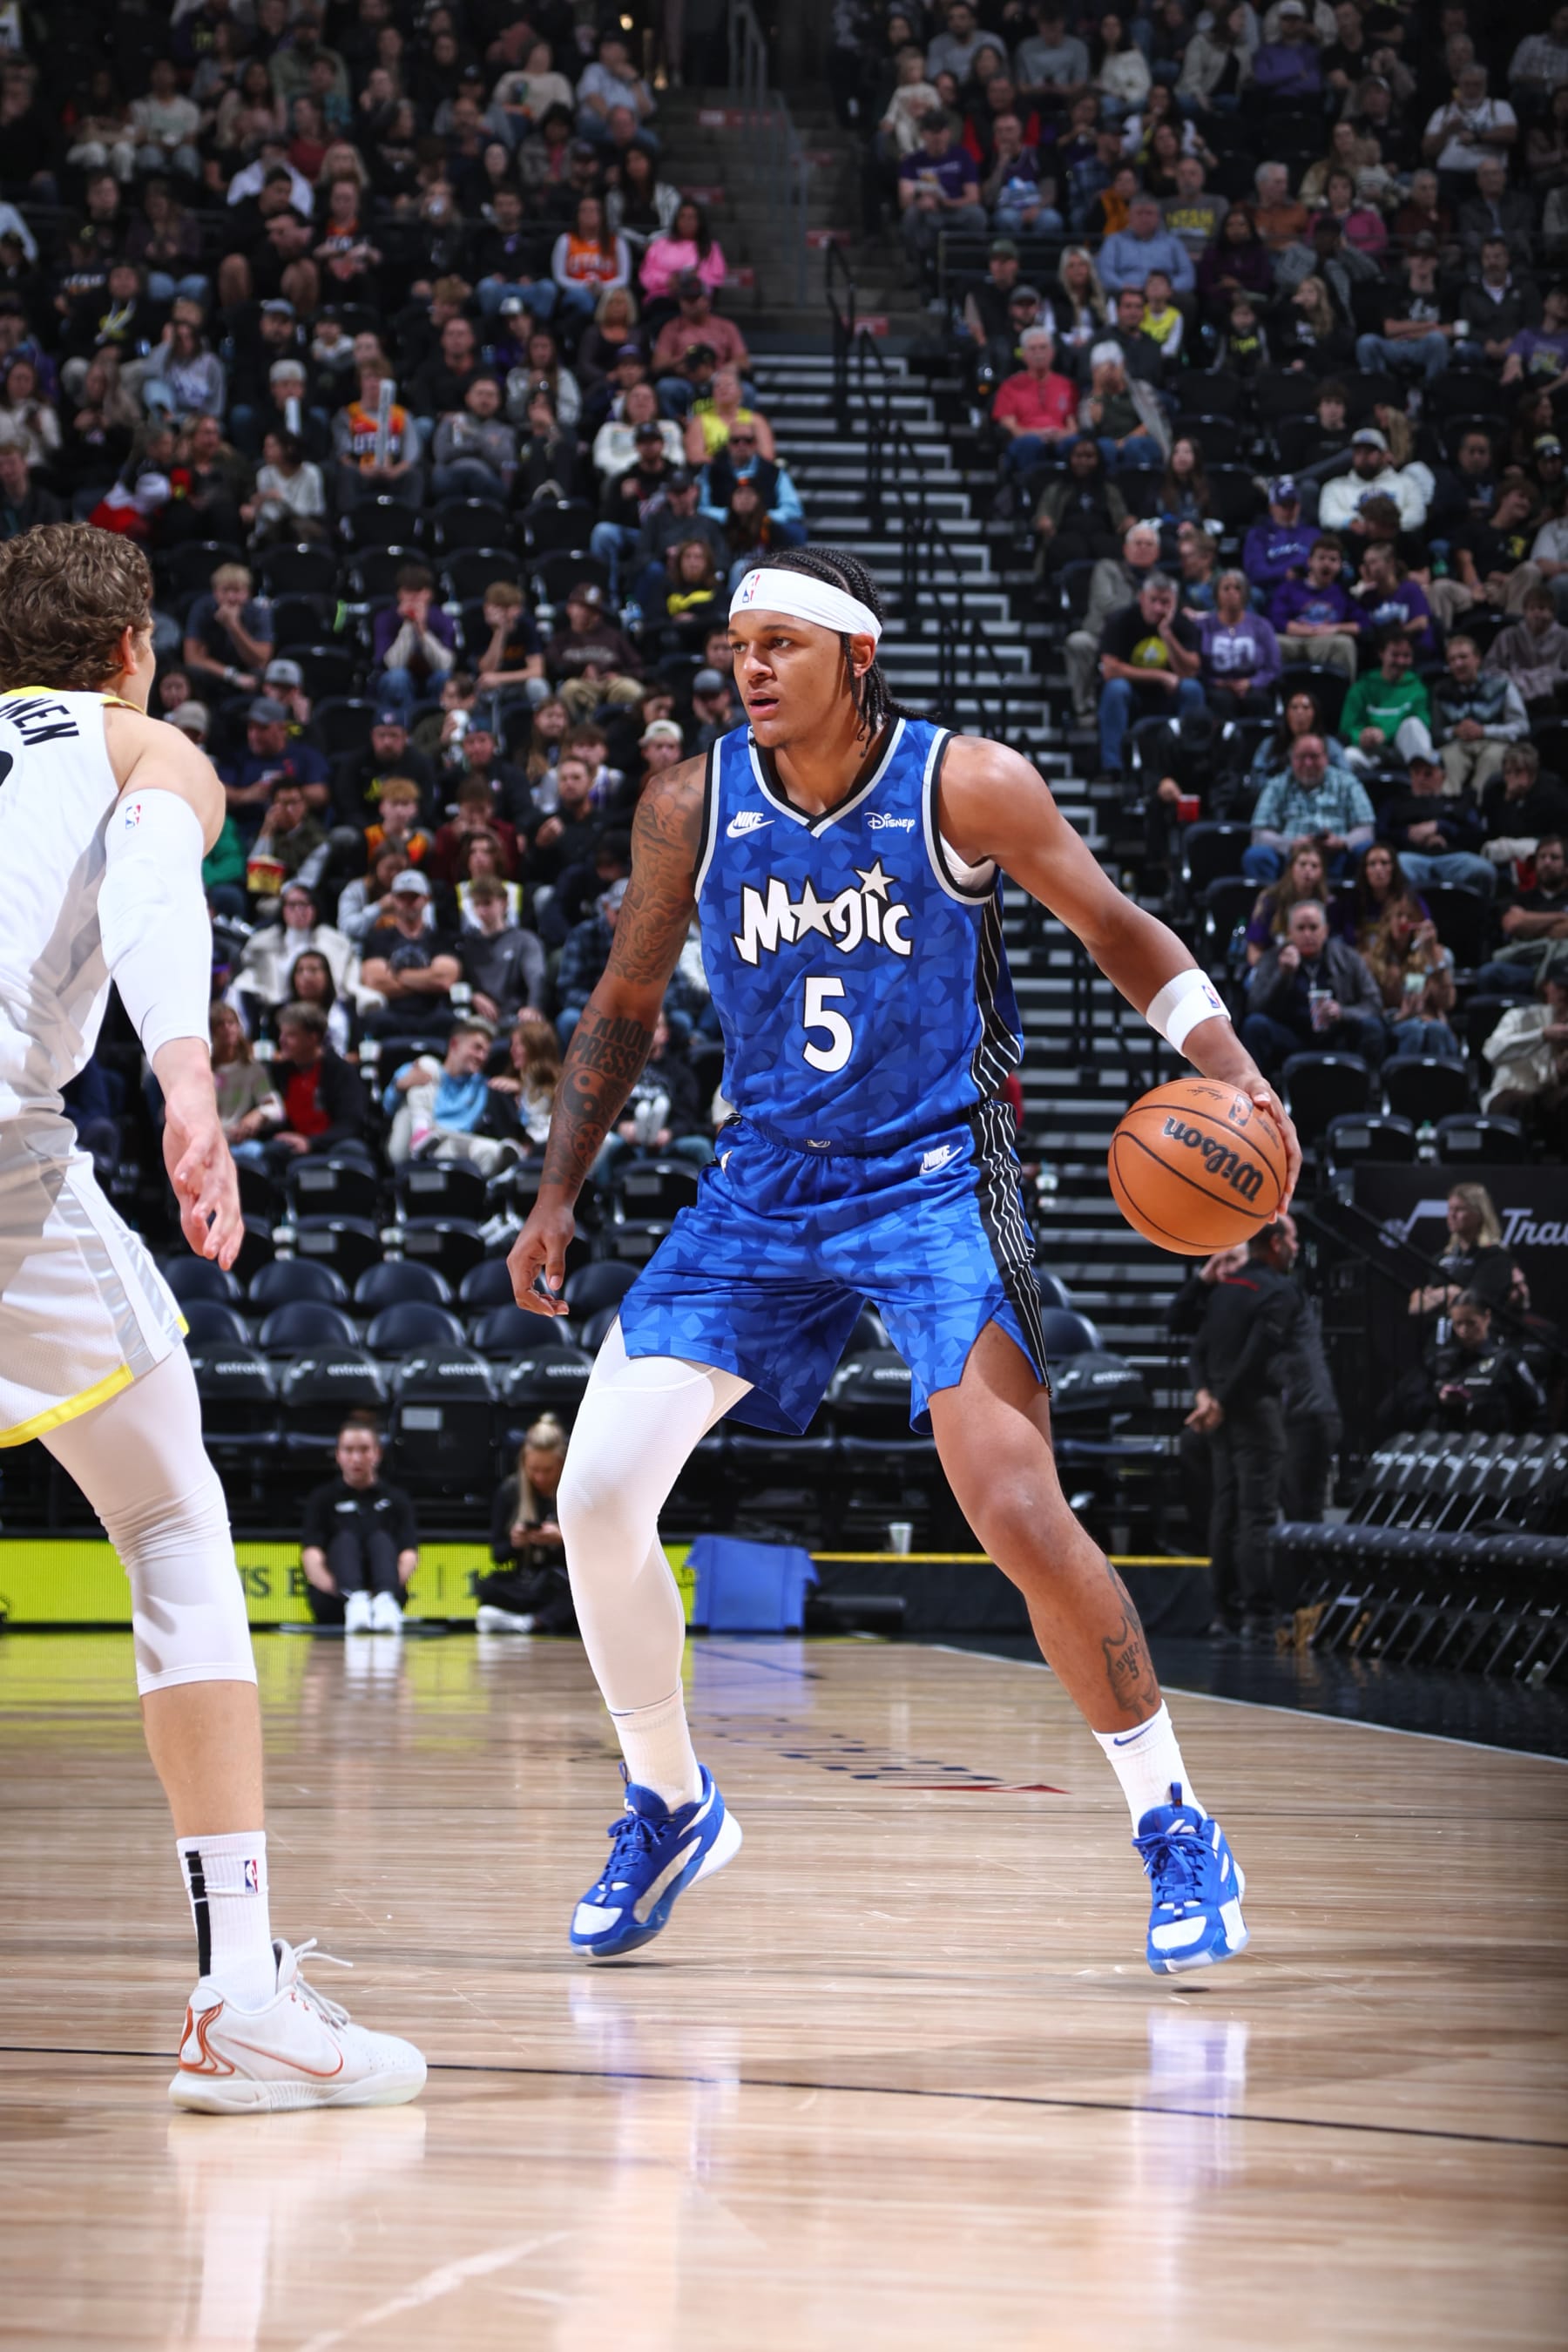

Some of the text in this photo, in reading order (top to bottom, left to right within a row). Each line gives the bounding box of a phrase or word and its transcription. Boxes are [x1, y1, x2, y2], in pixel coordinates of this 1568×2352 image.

[354, 432, 400, 453] UTH
[734, 811, 765, 827] NIKE
[864, 812, 916, 833] Disney
[802, 976, 854, 1072] 5
[923, 1144, 950, 1169] NIKE
[1162, 1114, 1264, 1203] Wilson
